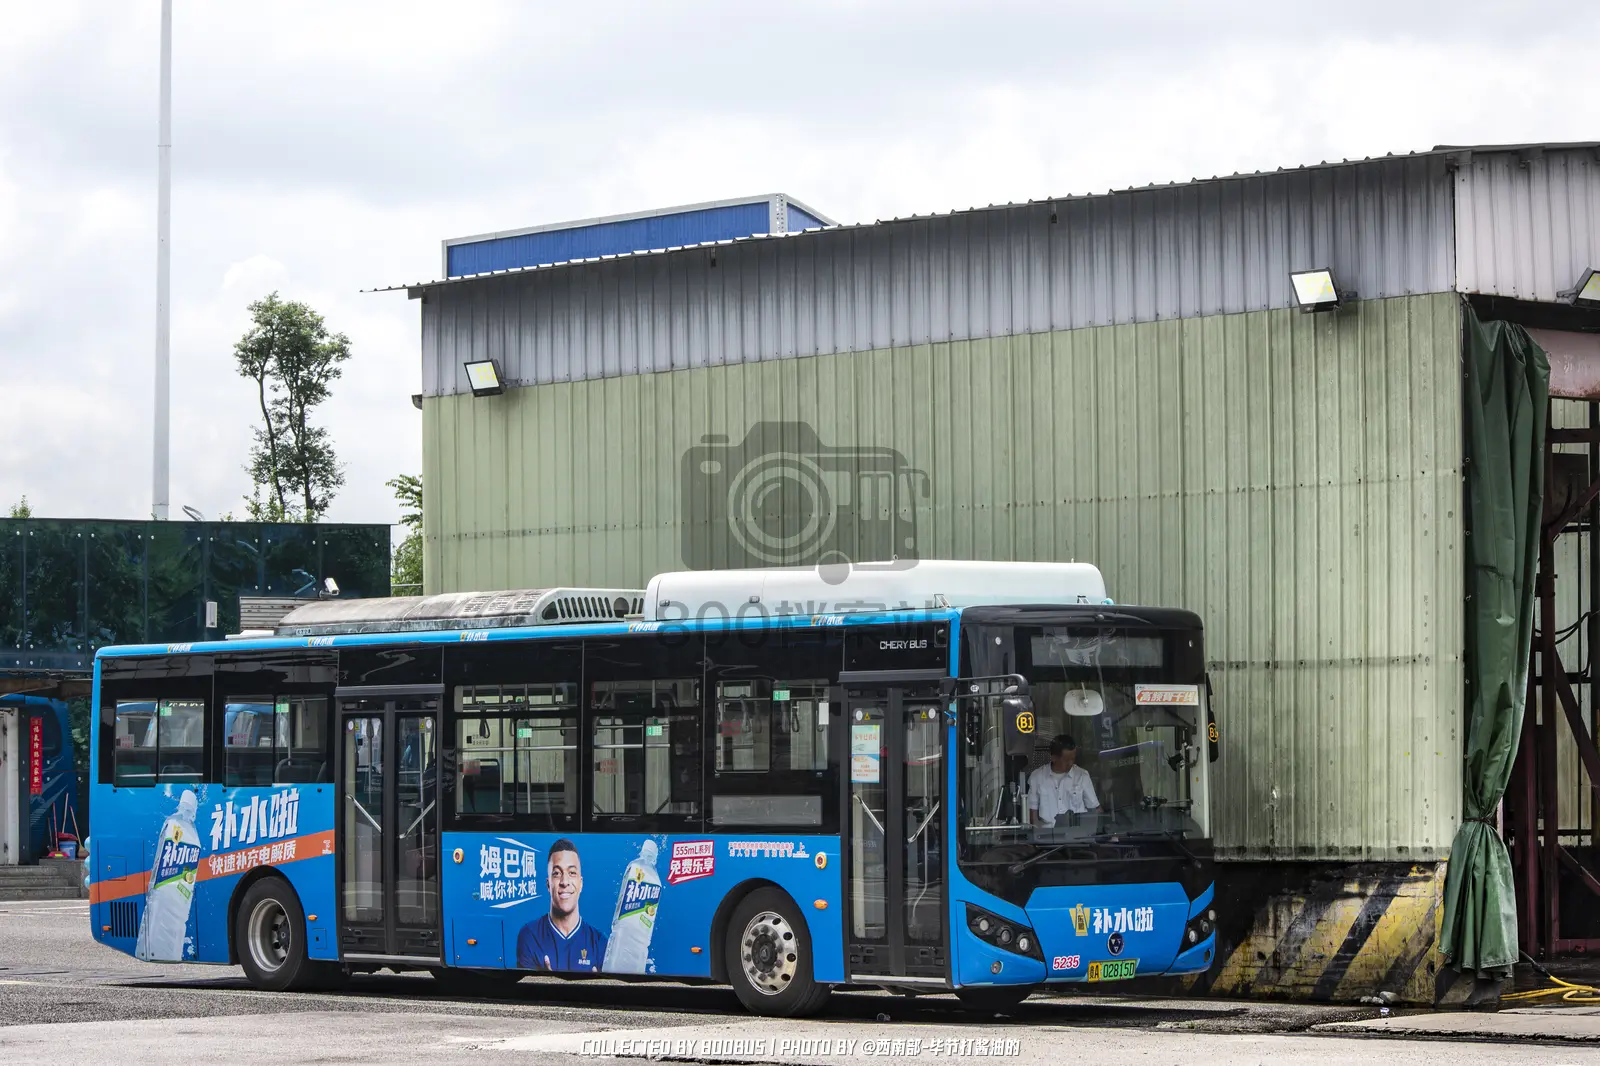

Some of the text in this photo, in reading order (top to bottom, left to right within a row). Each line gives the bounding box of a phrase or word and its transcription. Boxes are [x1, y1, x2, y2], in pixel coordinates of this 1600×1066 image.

[879, 639, 928, 650] CHERY BUS
[1020, 716, 1033, 729] B1
[210, 787, 299, 850] 补水啦
[162, 840, 200, 867] 补水啦
[211, 839, 297, 876] 快速补充电解质
[479, 843, 537, 879] 姆巴佩
[675, 844, 711, 856] 555mL系列
[670, 857, 714, 875] 免费乐享
[480, 879, 537, 901] 喊你补水啦
[626, 881, 661, 903] 补水啦
[1093, 906, 1154, 934] 补水啦
[1053, 955, 1080, 971] 5235
